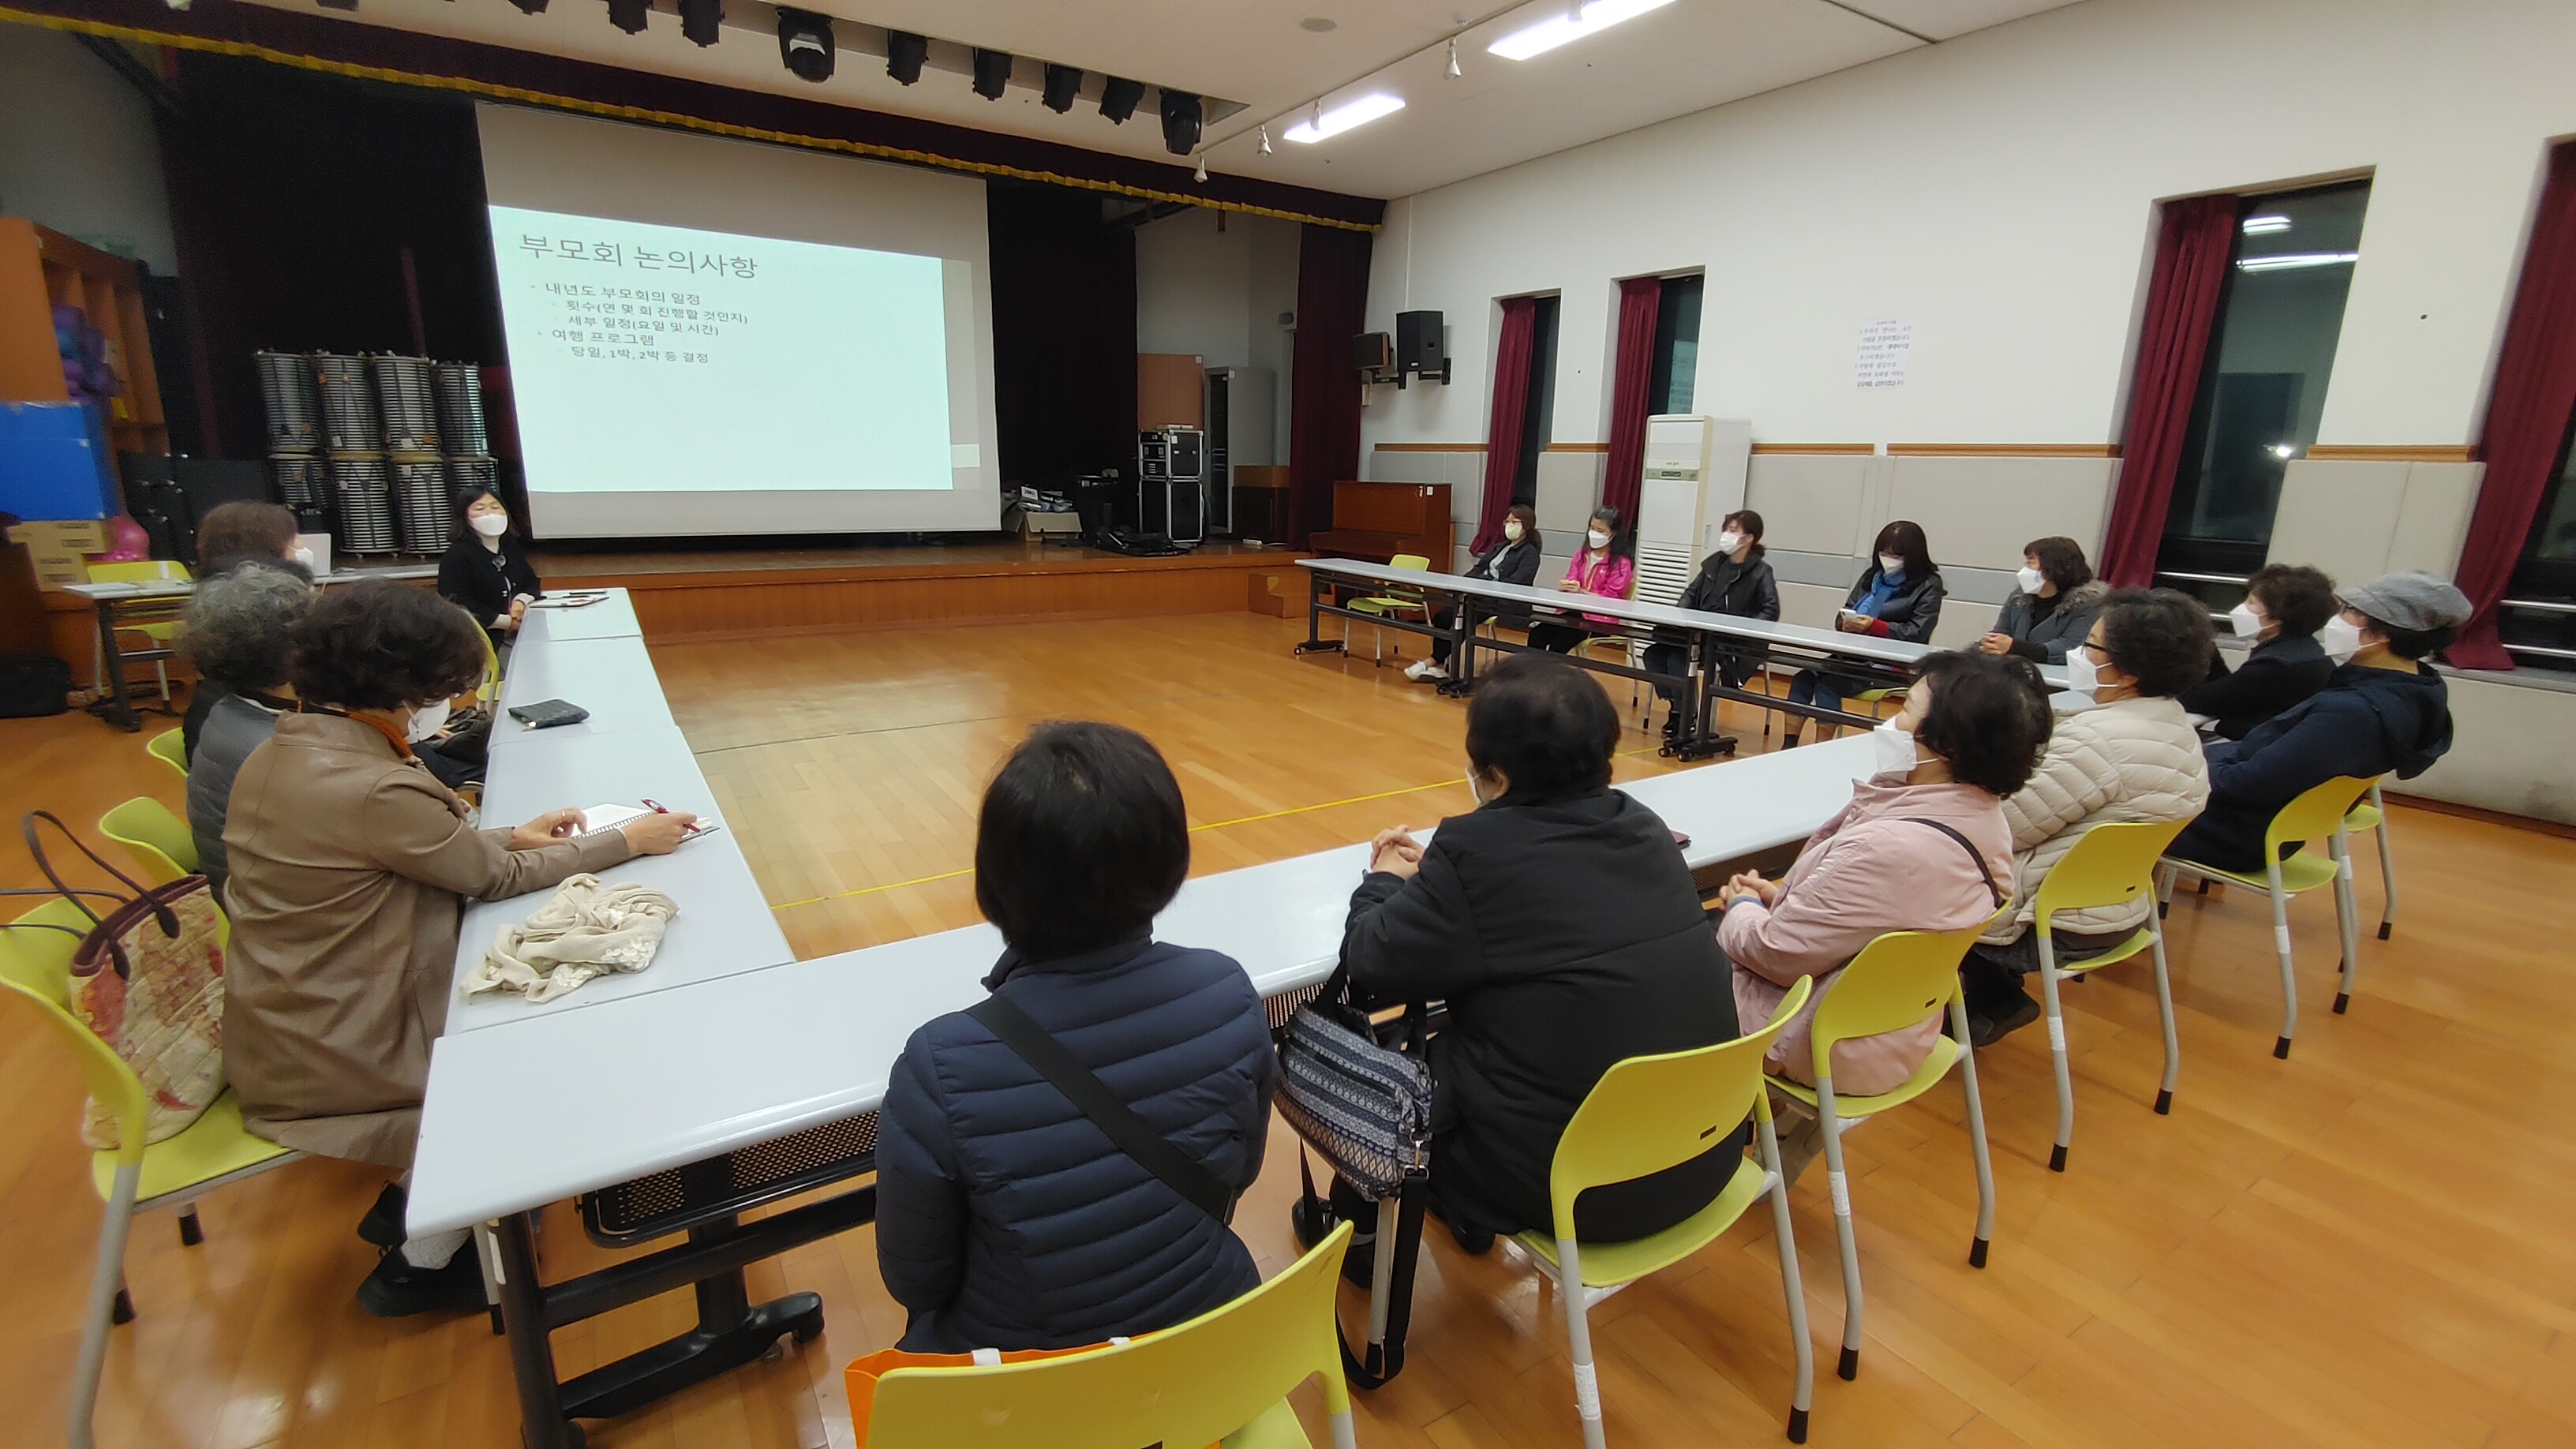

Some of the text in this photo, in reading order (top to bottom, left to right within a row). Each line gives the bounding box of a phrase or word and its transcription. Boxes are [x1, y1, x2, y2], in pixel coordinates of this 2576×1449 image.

[519, 234, 758, 279] 부모회 논의사항
[545, 282, 701, 305] 내년도 부모회의 일정
[639, 305, 652, 316] 회
[657, 306, 698, 320] 진행할
[703, 310, 748, 324] 것인지)
[568, 316, 719, 336] 세부 일정(요일 및 시간)
[552, 328, 654, 346] 여행 프로그램
[571, 346, 710, 364] 당일, 1박, 2박 등 결정
